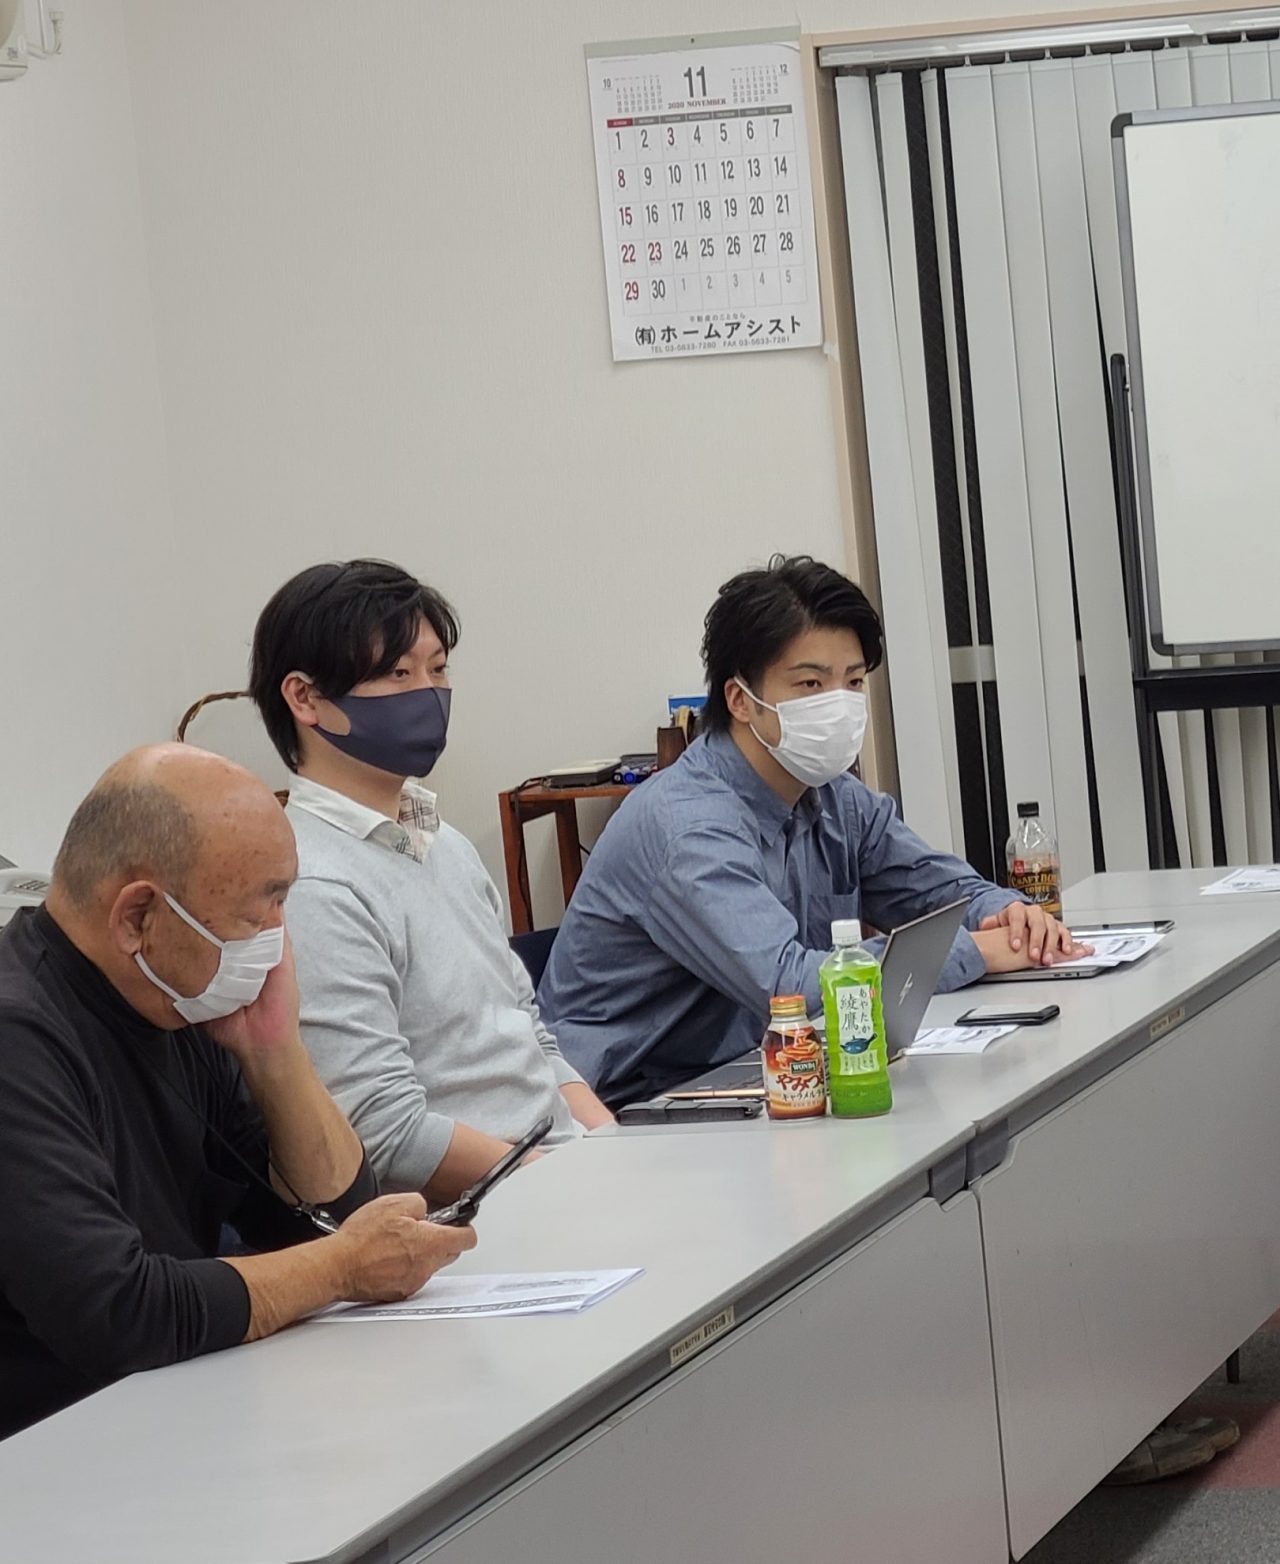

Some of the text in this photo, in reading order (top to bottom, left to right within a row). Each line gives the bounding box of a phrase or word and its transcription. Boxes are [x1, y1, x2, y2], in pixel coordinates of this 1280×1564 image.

[602, 77, 612, 89] 10
[683, 65, 707, 98] 11
[686, 98, 727, 109] NOVEMBER
[615, 118, 780, 151] 1 2 3 4 5 6 7
[617, 155, 788, 189] 8 9 10 11 12 13 14
[618, 193, 790, 226] 15 16 17 18 19 20 21
[620, 231, 794, 264] 22 23 24 25 26 27 28
[624, 281, 640, 301] 29
[651, 279, 666, 300] 30
